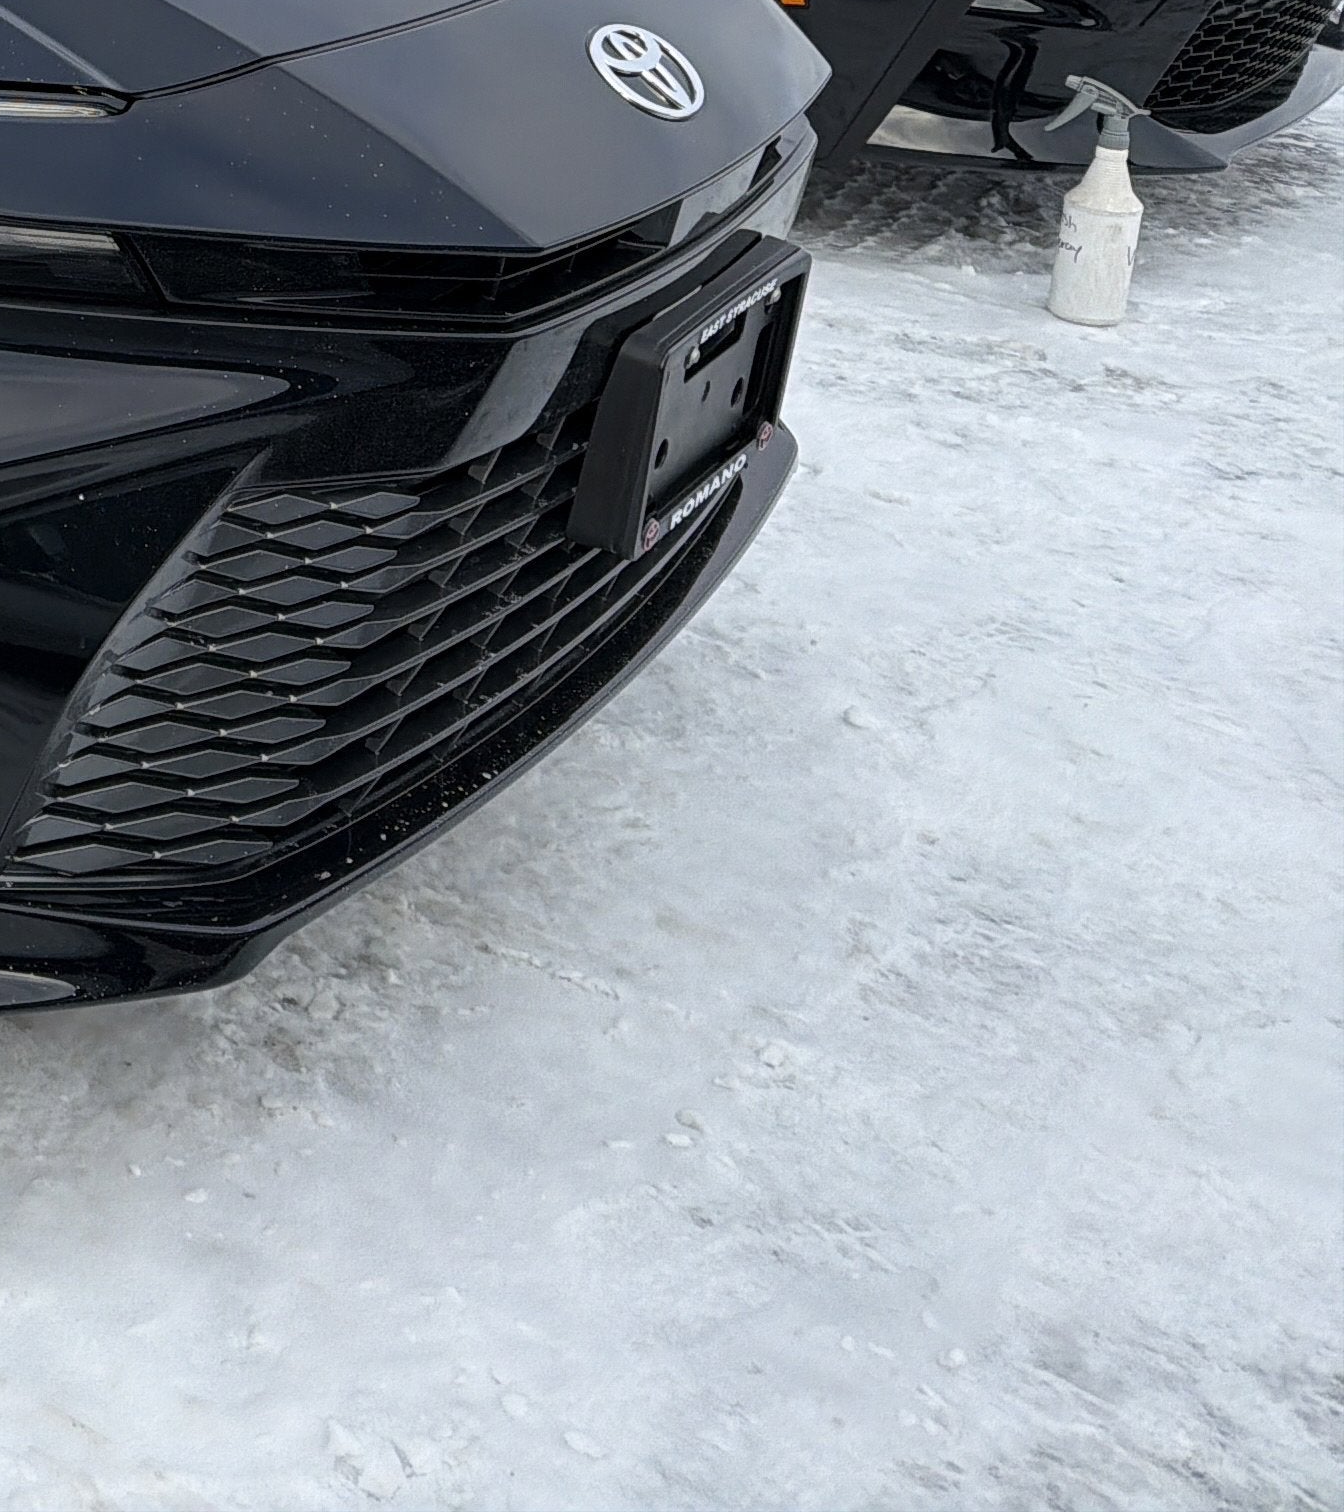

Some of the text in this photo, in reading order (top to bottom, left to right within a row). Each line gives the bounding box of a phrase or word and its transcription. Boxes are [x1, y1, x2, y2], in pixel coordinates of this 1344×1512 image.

[699, 277, 779, 345] EAST SYRACUSE
[669, 453, 747, 531] ROMANO
